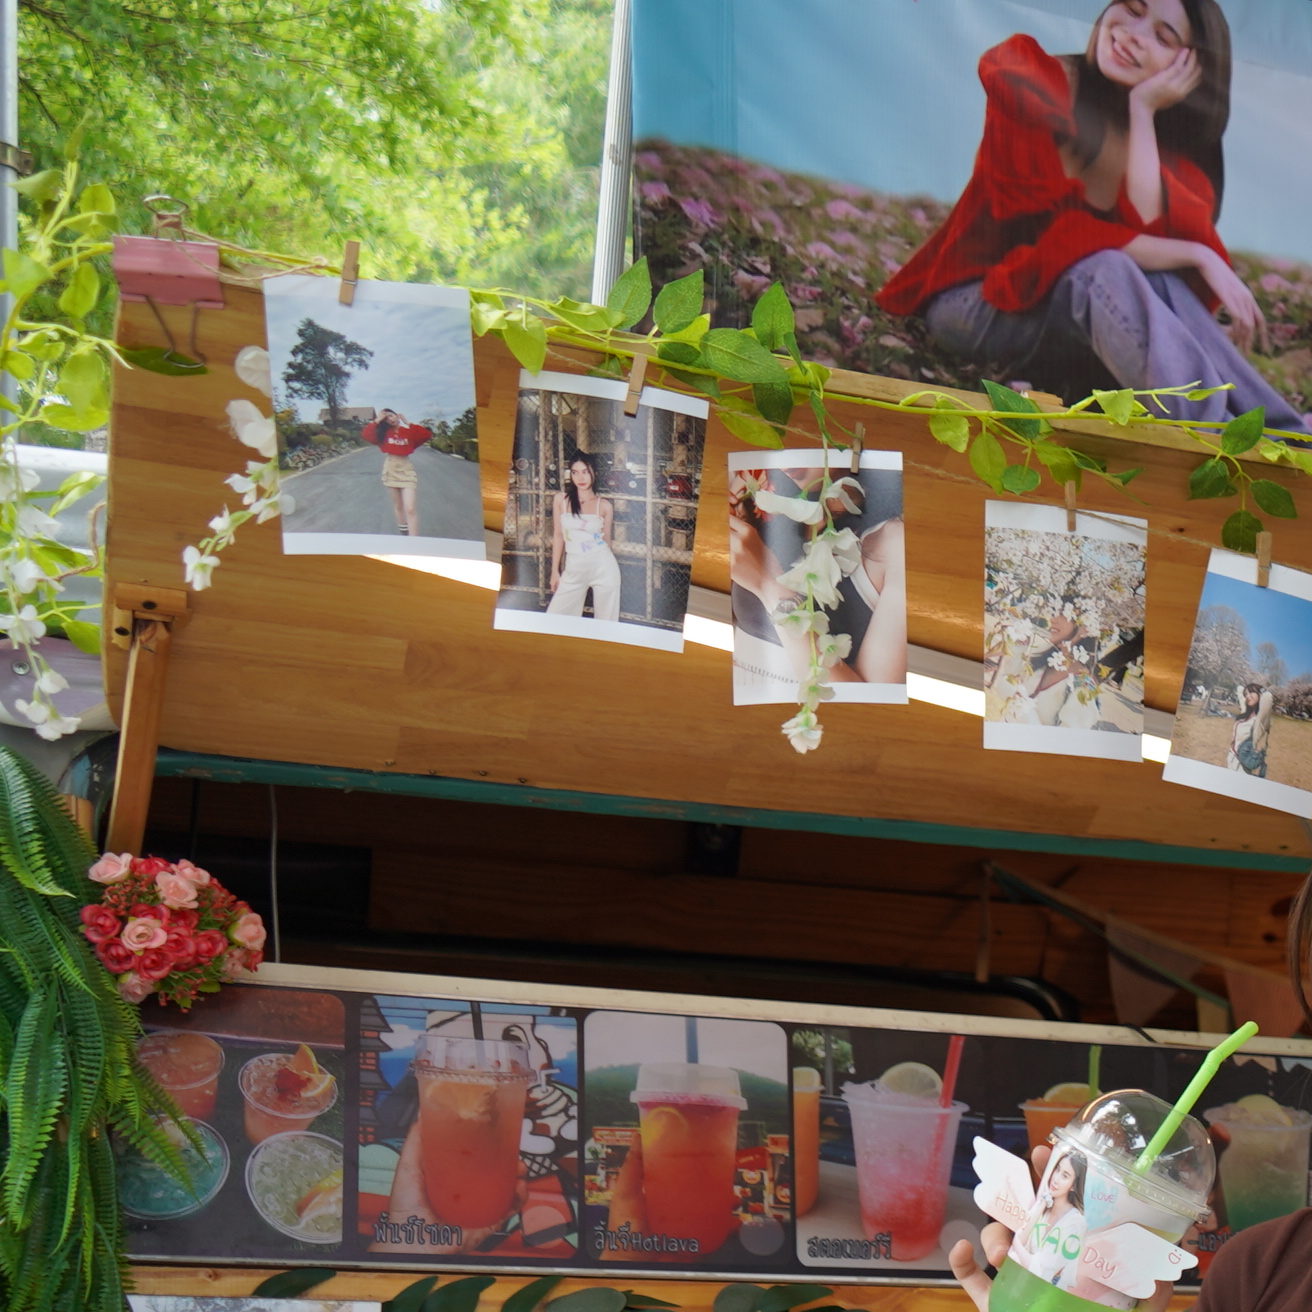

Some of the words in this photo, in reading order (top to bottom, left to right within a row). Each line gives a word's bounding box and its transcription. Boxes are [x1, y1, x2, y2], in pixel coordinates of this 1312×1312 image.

[1090, 1189, 1116, 1204] LOVE
[994, 1193, 1031, 1231] Happy
[1028, 1215, 1083, 1261] KAO
[1082, 1246, 1117, 1280] Day
